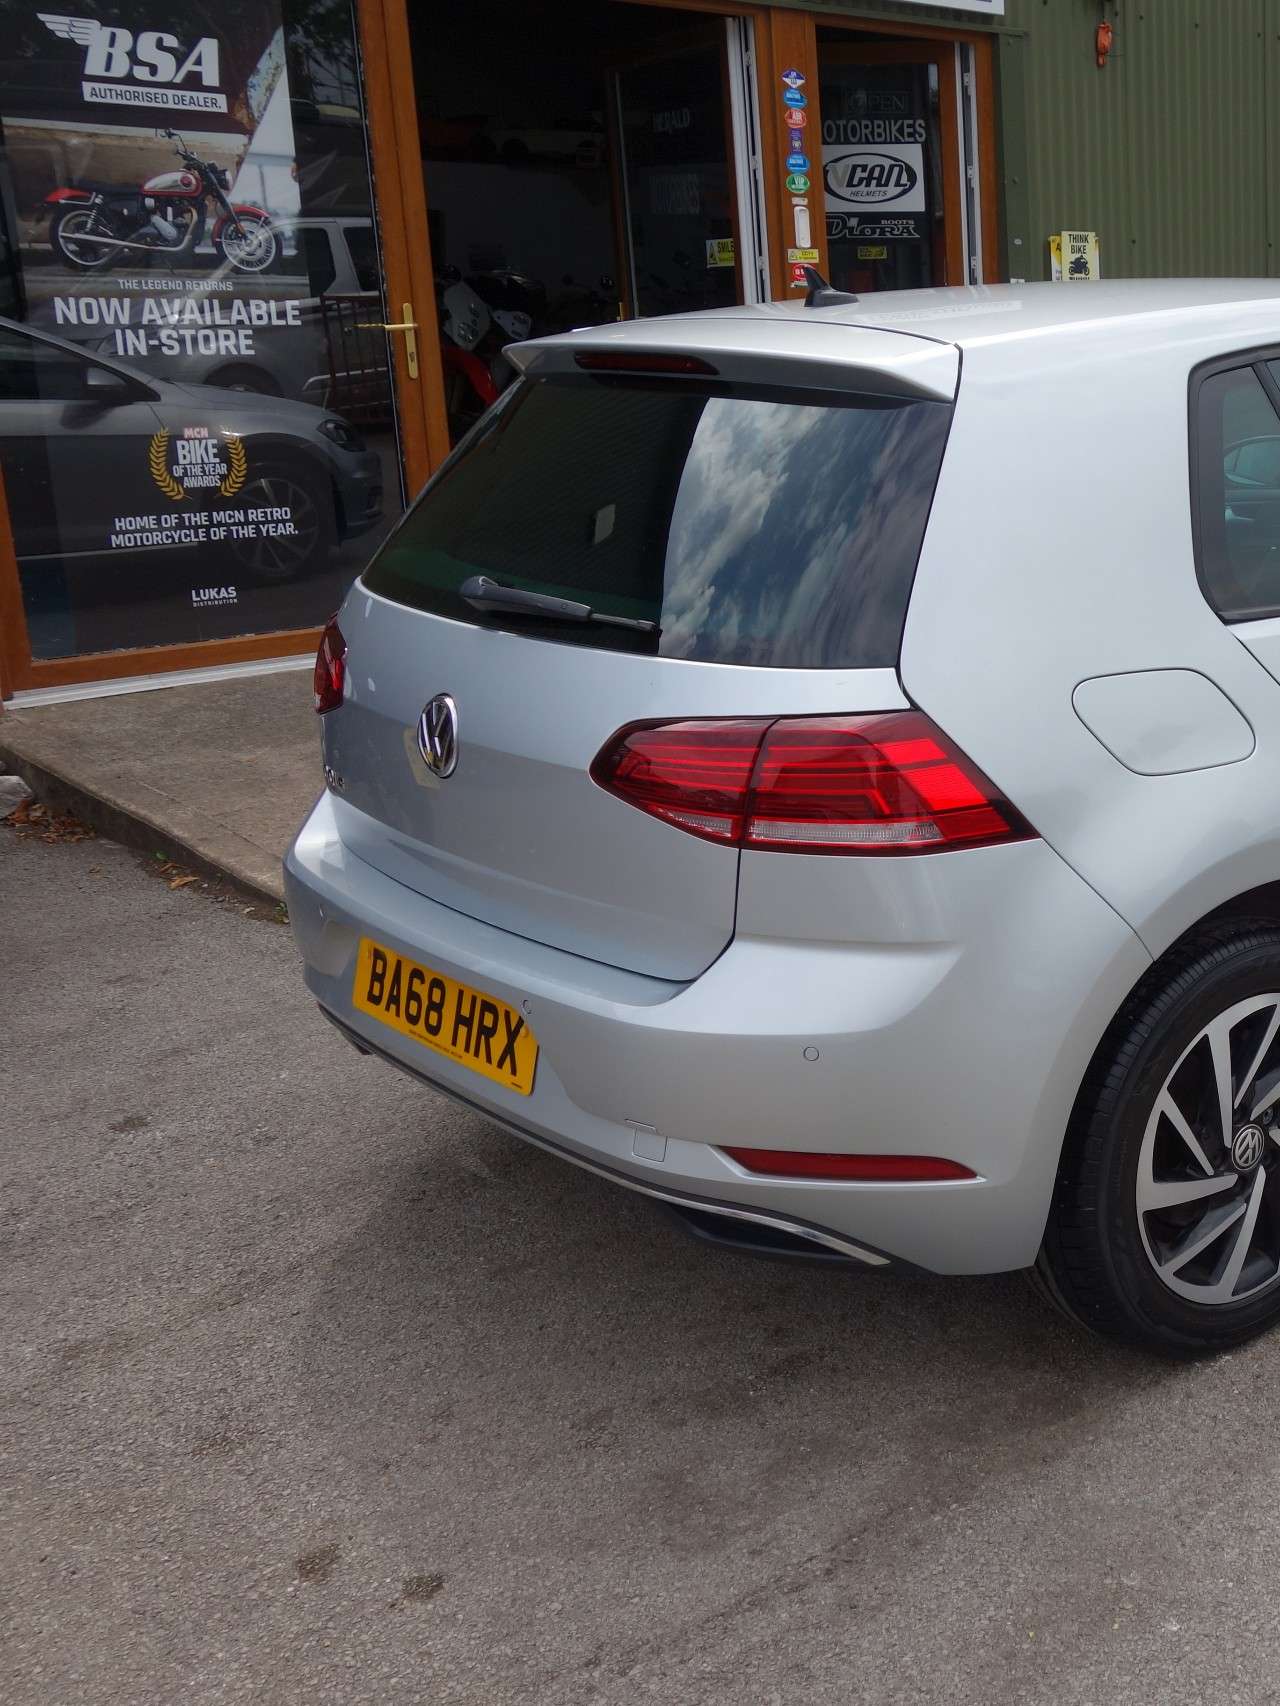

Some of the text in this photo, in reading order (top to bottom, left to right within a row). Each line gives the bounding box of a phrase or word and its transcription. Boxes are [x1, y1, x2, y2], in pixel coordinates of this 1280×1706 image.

[83, 26, 220, 87] BSA
[89, 87, 222, 109] AUTHORISED DEALER.
[823, 119, 927, 142] OTORBIKES
[1068, 233, 1089, 243] THINK
[1070, 244, 1087, 254] BIKE
[118, 279, 234, 291] THE LEGEND RETURNS
[53, 297, 302, 326] NOW AVAILABLE
[114, 328, 256, 356] IN-STORE
[176, 438, 221, 464] BIKE
[172, 463, 228, 477] OF THE YEAR
[183, 475, 222, 488] AWARDS
[114, 507, 291, 531] HOME OF THE MCN RETRO
[111, 522, 299, 548] MOTORCYCLE OF THE YEAR.
[191, 586, 237, 601] LUKAS
[192, 598, 238, 608] DISTRIBUTION
[366, 946, 525, 1078] BA68 HRX
